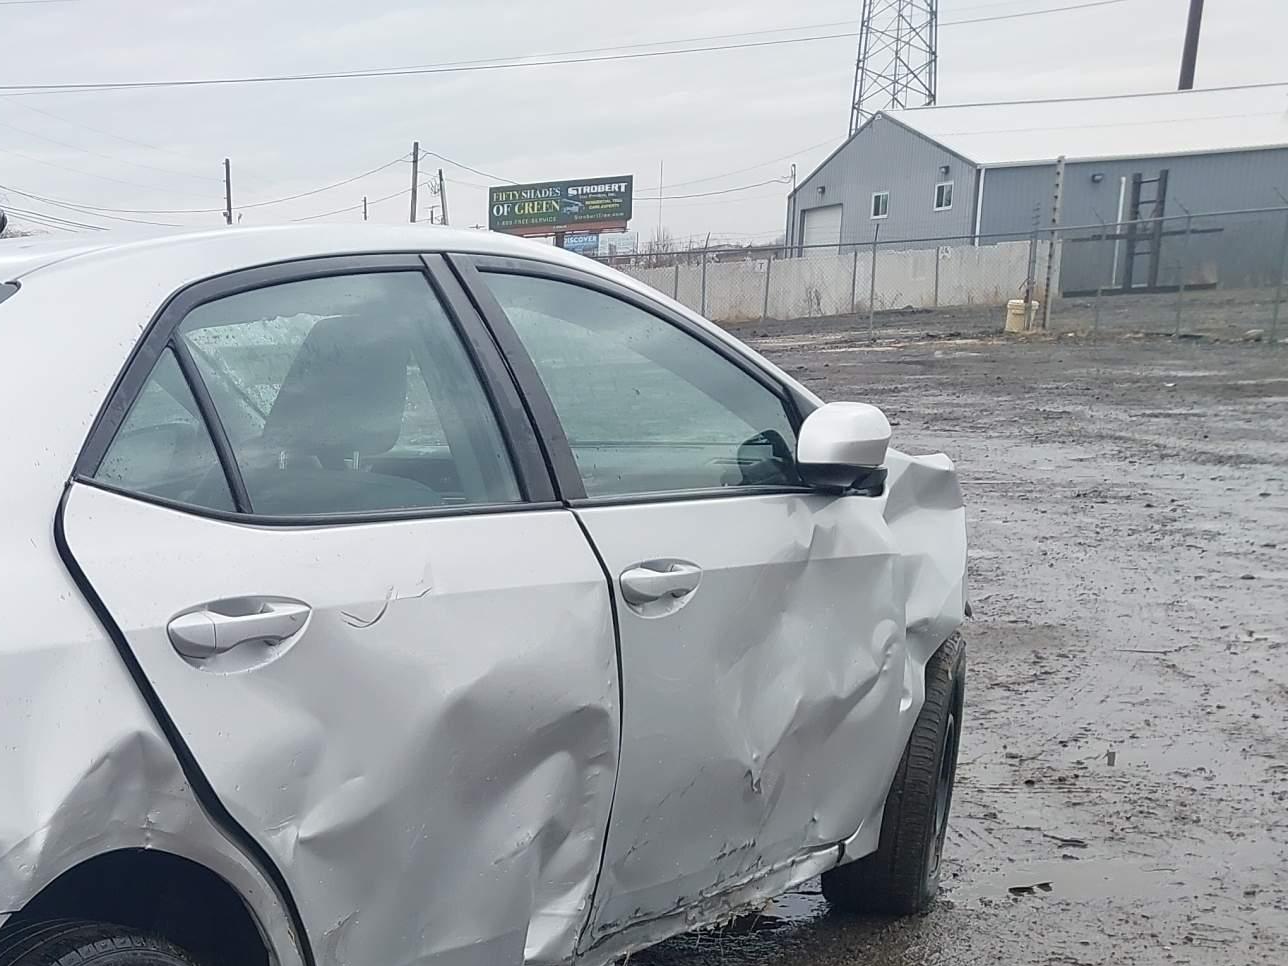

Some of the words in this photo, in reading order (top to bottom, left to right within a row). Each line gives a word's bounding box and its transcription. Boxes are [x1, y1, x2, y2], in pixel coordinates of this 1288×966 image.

[493, 191, 520, 202] FIFTY
[521, 187, 561, 199] SHADES
[567, 182, 628, 197] STROBERT
[493, 203, 512, 217] OF
[514, 199, 560, 215] GREEN
